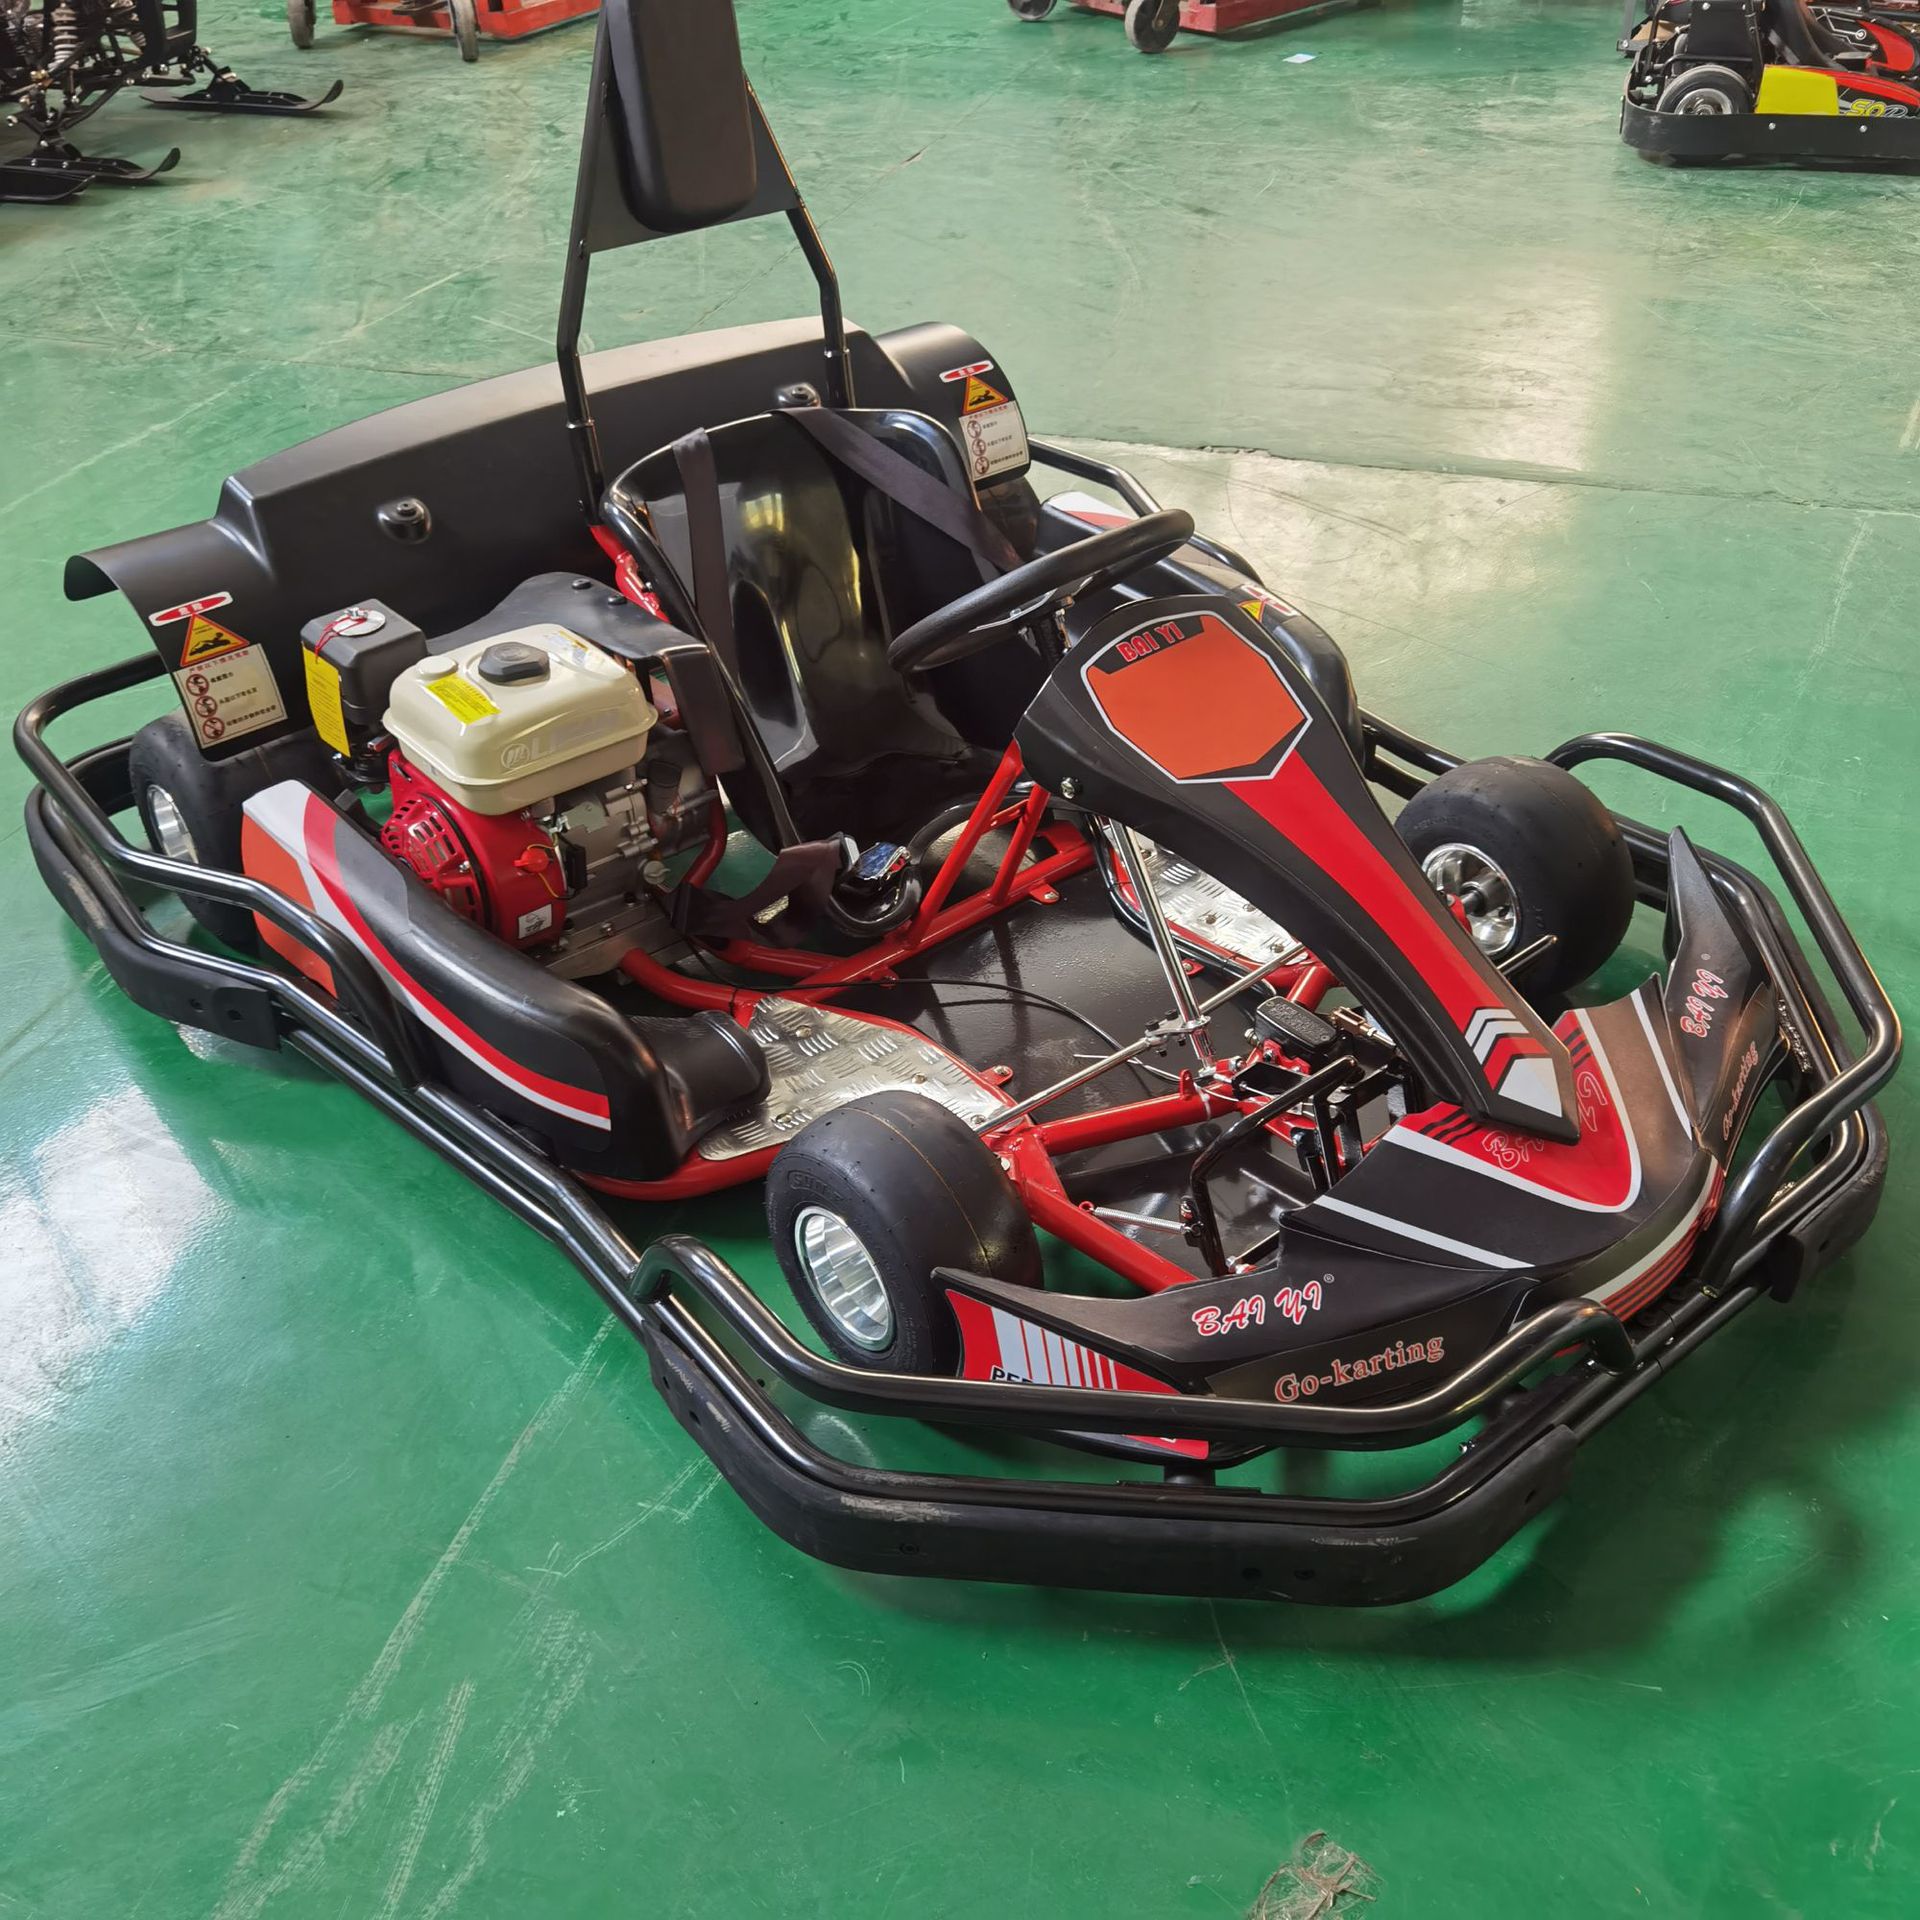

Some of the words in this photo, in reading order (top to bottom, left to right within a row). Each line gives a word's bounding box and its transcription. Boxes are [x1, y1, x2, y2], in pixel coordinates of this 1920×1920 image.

[1115, 631, 1160, 662] BAI
[1153, 621, 1185, 644] YI
[1692, 968, 1729, 999] YI
[1680, 995, 1715, 1038] BAI
[1191, 1294, 1266, 1337] BAI
[1273, 1280, 1323, 1326] YI
[1274, 1336, 1445, 1403] Go-karting
